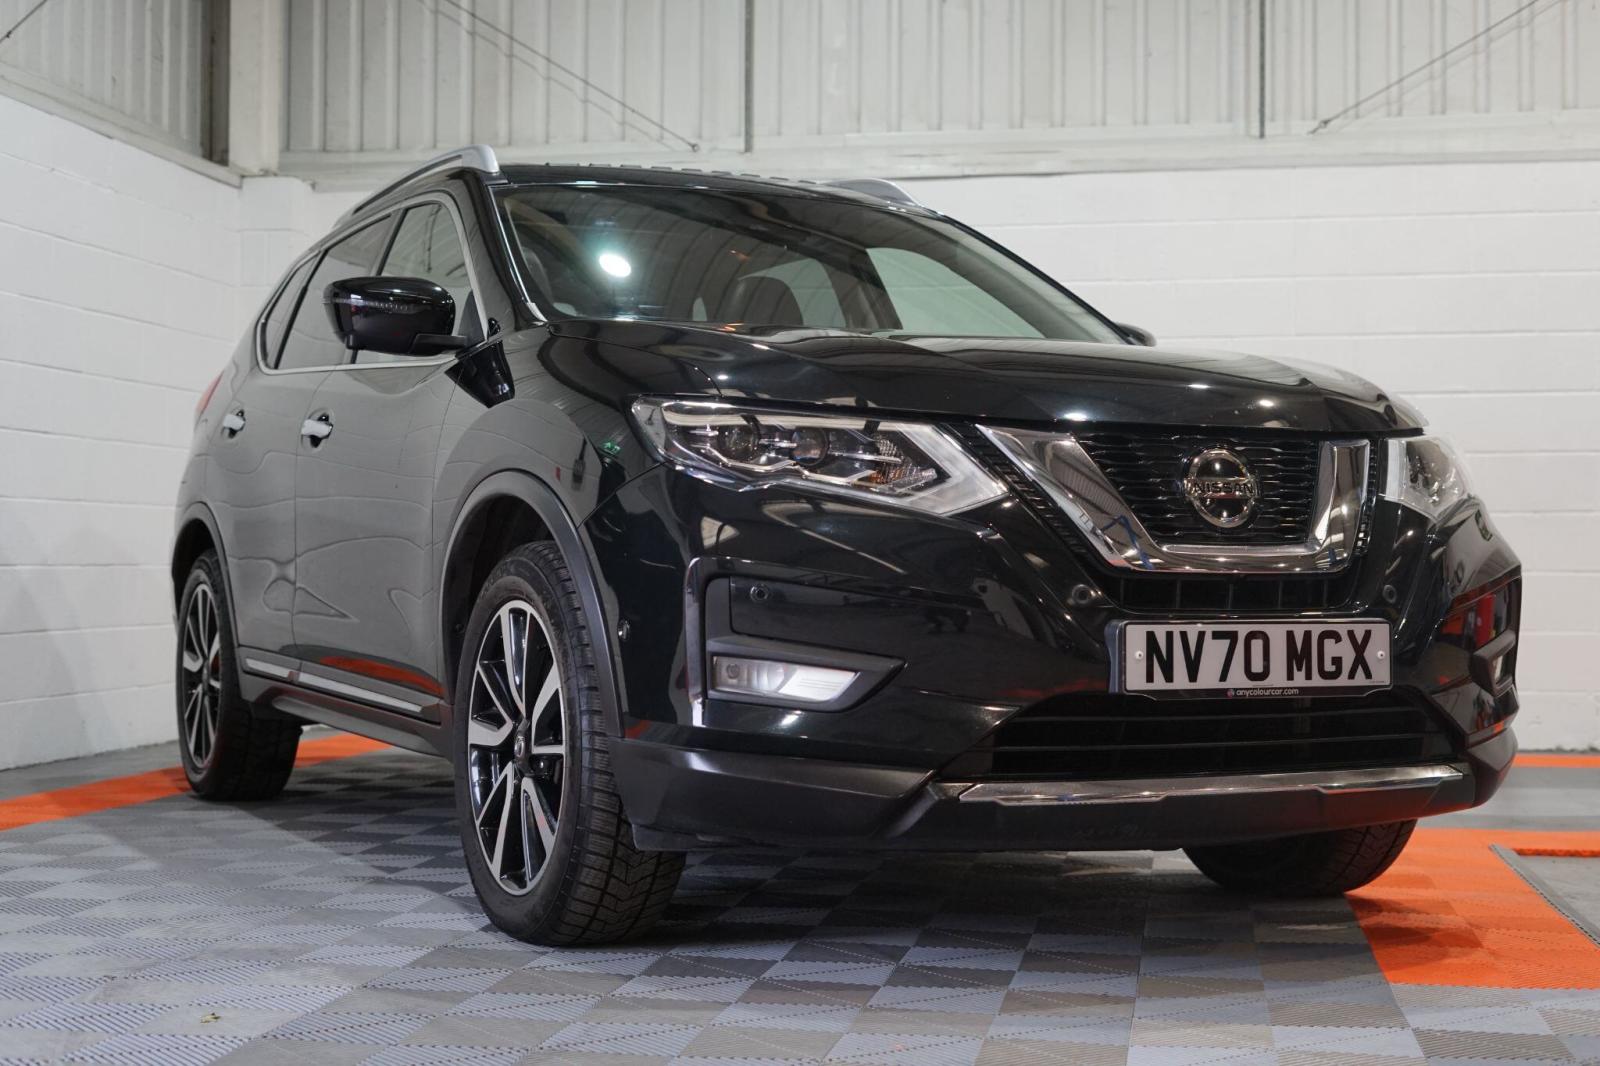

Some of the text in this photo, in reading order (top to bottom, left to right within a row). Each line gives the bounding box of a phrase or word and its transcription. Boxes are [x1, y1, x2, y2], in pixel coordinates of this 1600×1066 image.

[1194, 481, 1254, 494] NISSAN
[1145, 629, 1373, 683] NV70 MGX
[1236, 687, 1299, 697] anycolourcar.com
